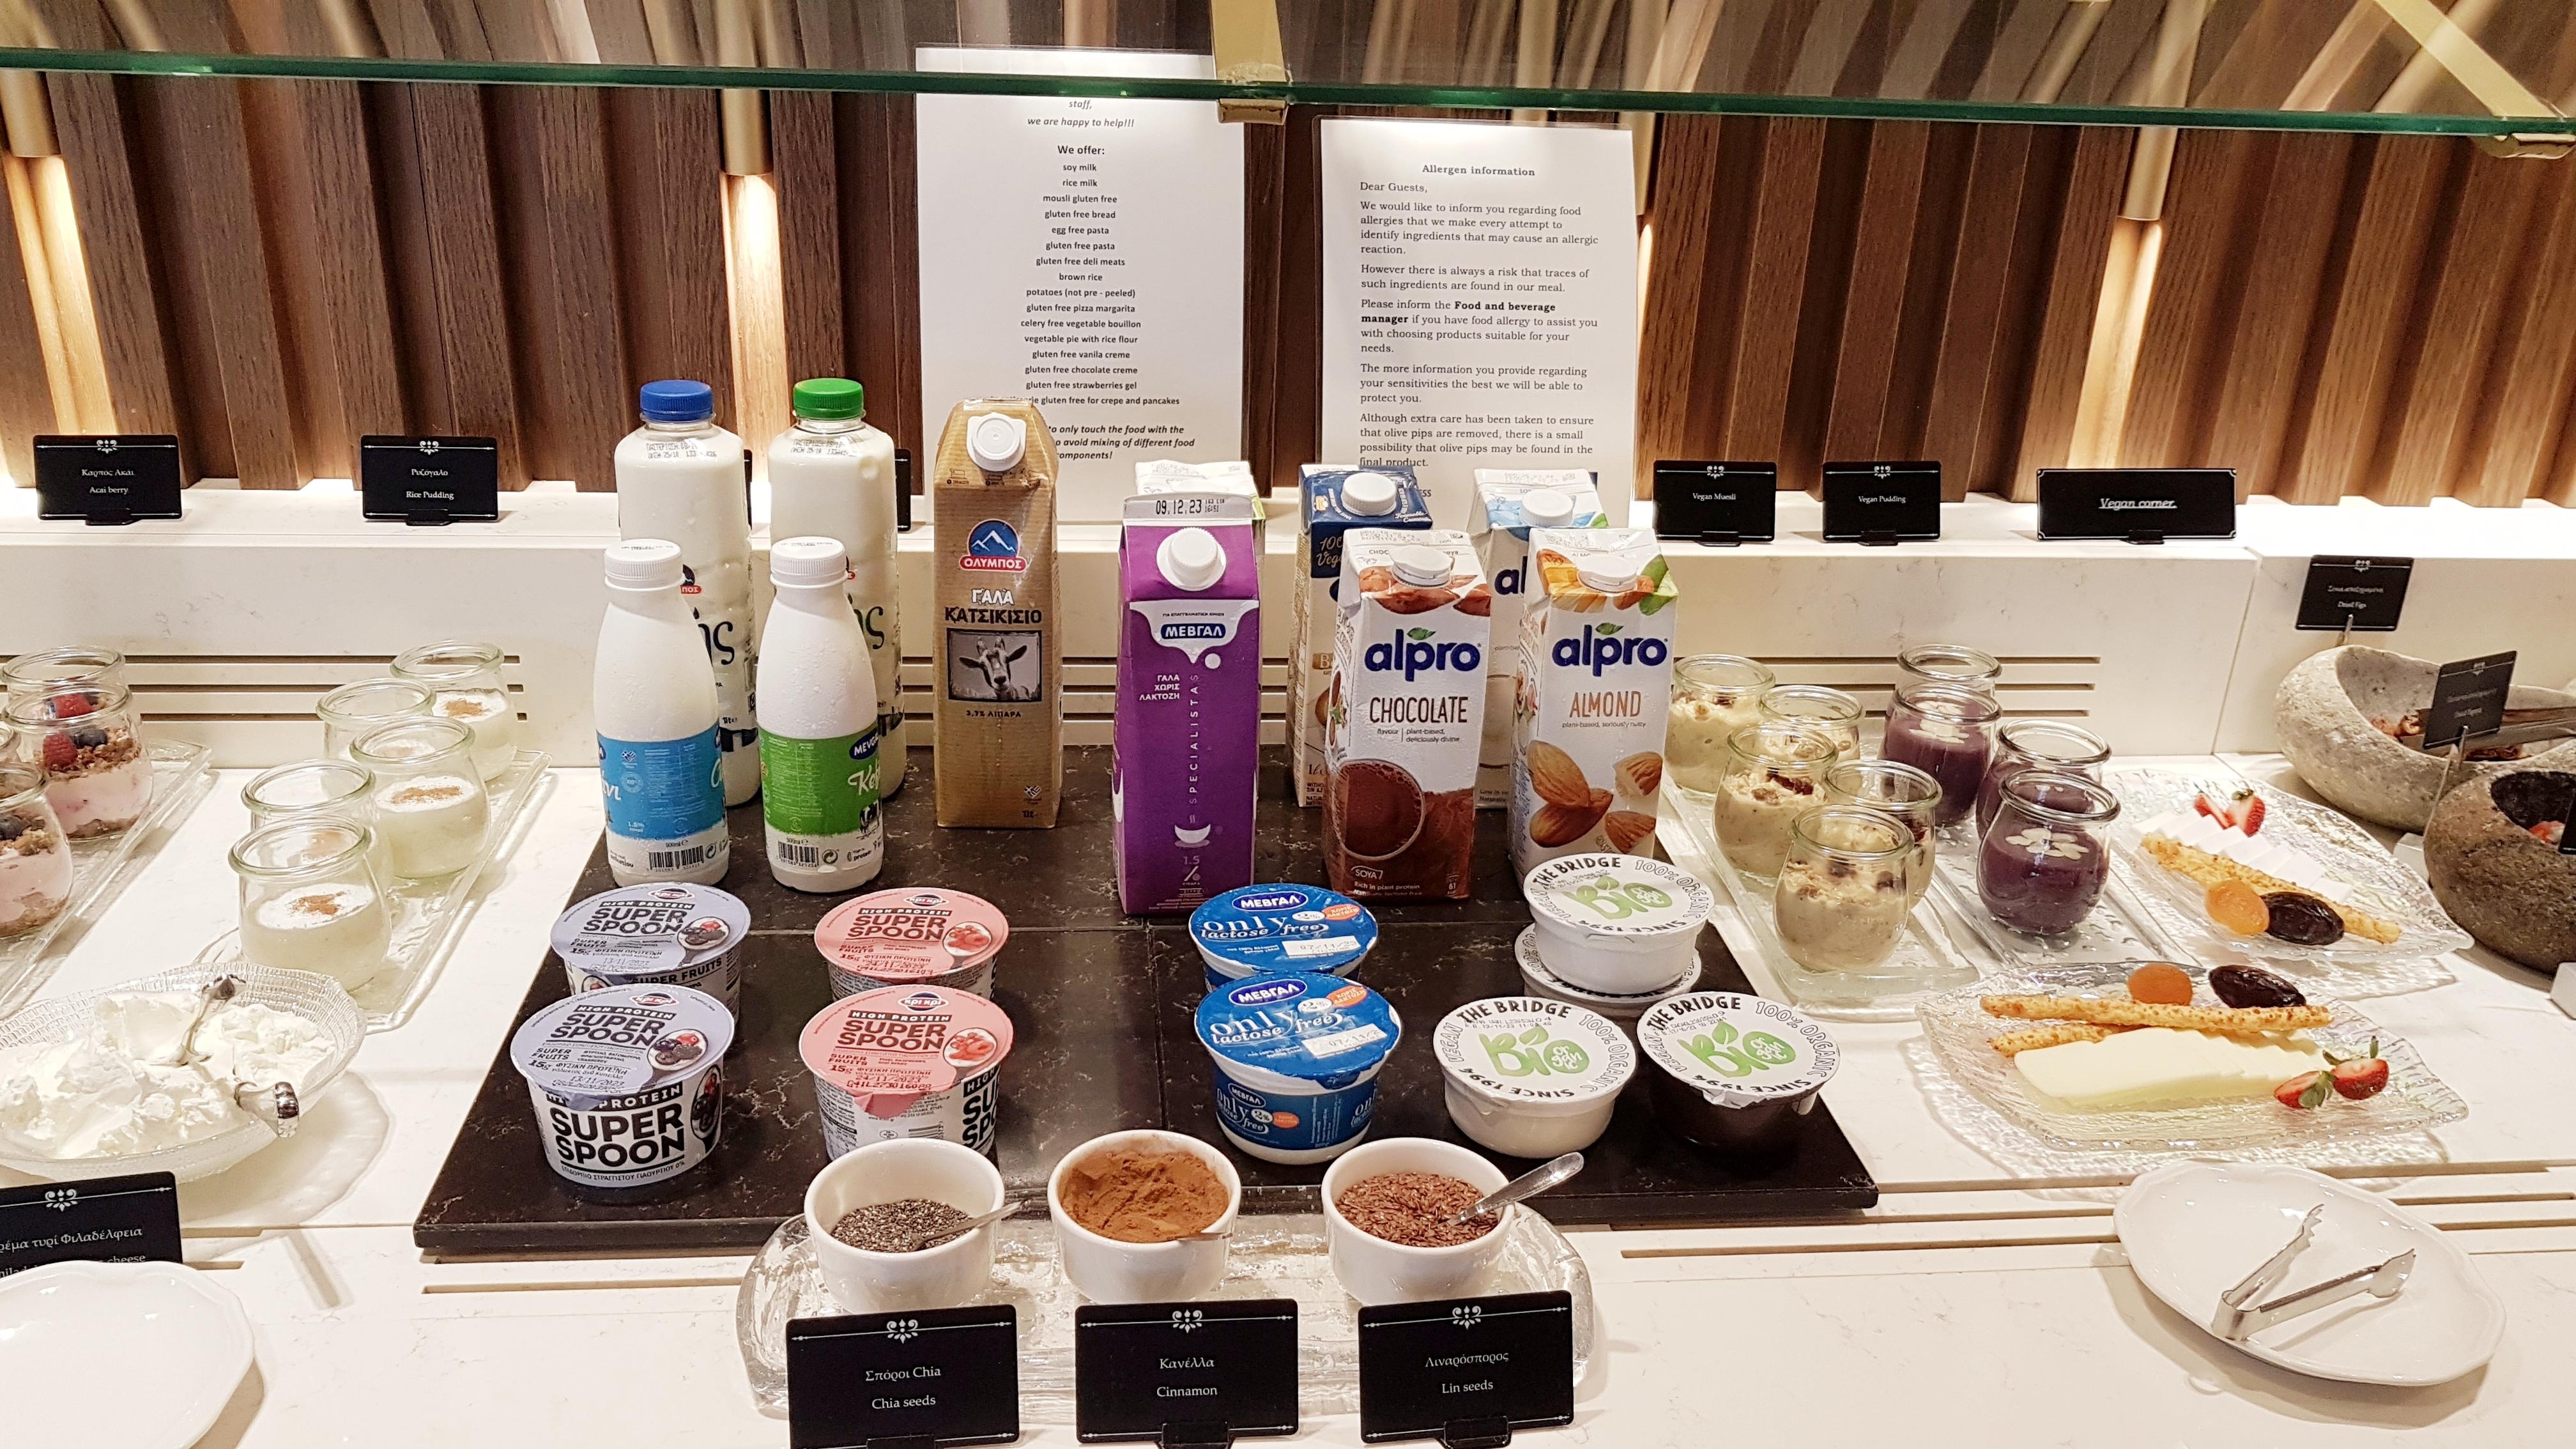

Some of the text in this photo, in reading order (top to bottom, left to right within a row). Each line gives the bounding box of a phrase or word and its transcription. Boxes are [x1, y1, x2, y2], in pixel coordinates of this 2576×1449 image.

[1068, 98, 1092, 111] staff,
[1061, 117, 1090, 128] happy
[1103, 118, 1135, 129] help!!!
[1057, 145, 1105, 155] We offer:
[1079, 163, 1097, 172] milk
[1422, 164, 1535, 176] Allergen information
[1359, 181, 1427, 194] Dear Guests,
[1072, 194, 1099, 204] gluten
[1101, 195, 1117, 203] free
[1360, 201, 1376, 211] We
[1379, 201, 1411, 211] would
[1414, 202, 1432, 212] like
[1449, 203, 1483, 213] inform
[1485, 206, 1505, 216] you
[1508, 204, 1557, 217] regarding
[1560, 206, 1581, 216] food
[1026, 289, 1062, 297] potatoes
[1064, 288, 1082, 298] (not
[1105, 289, 1135, 299] peeled)
[1361, 298, 1556, 314] Please inform the Food and beverage
[1020, 319, 1141, 330] celery free vegetable bouillon
[1063, 437, 1195, 448] avoid mixing of different food
[107, 486, 128, 495] berry
[422, 491, 454, 500] Pudding
[1692, 492, 1712, 502] Vegan
[1156, 500, 1202, 515] 09.12.23
[1858, 495, 1906, 505] Vegan Pudding
[2100, 498, 2136, 510] Vegan
[964, 558, 1022, 569] ΟΛΥΜΠΟΣ
[972, 588, 1015, 606] ΓΑΛΑ
[945, 607, 1042, 624] ΚΑΤΣΙΚΙΣΙΟ
[1165, 626, 1222, 637] ΜΕΒΓΑΛ
[1365, 629, 1480, 682] alpro
[1552, 624, 1667, 677] alpro
[1370, 696, 1468, 723] CHOCOLATE
[1569, 691, 1641, 718] ALMOND
[1355, 870, 1377, 879] SOYA
[1533, 869, 1558, 888] THE
[1554, 857, 1621, 873] BRIDGE
[1354, 881, 1368, 889] Rich
[1636, 860, 1707, 919] 100% ORGANIC
[1241, 896, 1301, 908] ΜΕΒΓΑΛ
[592, 907, 687, 923] SUPER
[853, 915, 947, 928] SUPER
[584, 920, 682, 935] SPOON
[1201, 924, 1322, 939] lactose free
[1204, 916, 1288, 934] only
[1579, 920, 1687, 933] SINCE 1994
[848, 926, 944, 940] SPOON
[681, 958, 722, 981] FRUITS
[1238, 984, 1300, 1003] ΜΕΒΓΑΛ
[615, 1008, 673, 1019] PROTEIN
[1457, 1000, 1572, 1022] THE BRIDGE
[1646, 1010, 1675, 1031] THE
[1668, 996, 1741, 1016] BRIDGE
[562, 1013, 666, 1035] SUPER
[843, 1020, 947, 1038] SUPER
[1210, 1009, 1294, 1036] only
[1213, 1015, 1335, 1044] lactose free
[550, 1025, 657, 1046] SPOON
[838, 1032, 944, 1050] SPOON
[1756, 1001, 1803, 1029] 100%
[1800, 1025, 1835, 1078] ORGANIC
[1579, 1014, 1629, 1092] 100% ORGANIC
[1458, 1068, 1575, 1098] SINCE 1994
[1692, 1075, 1812, 1093] SINCE 1994
[549, 1103, 684, 1142] SUPER
[556, 1128, 685, 1167] SPOON
[0, 1227, 142, 1253] ρέμα τυρί Φιλαδέλφεια
[1159, 1357, 1215, 1370] Κανέλλα
[1425, 1352, 1508, 1368] Λιναρόσπορος
[865, 1365, 941, 1383] Σπόροι Chia
[1156, 1385, 1218, 1397] Cinnamon
[1441, 1379, 1494, 1394] Lin seeds
[871, 1394, 936, 1409] Chia seeds
